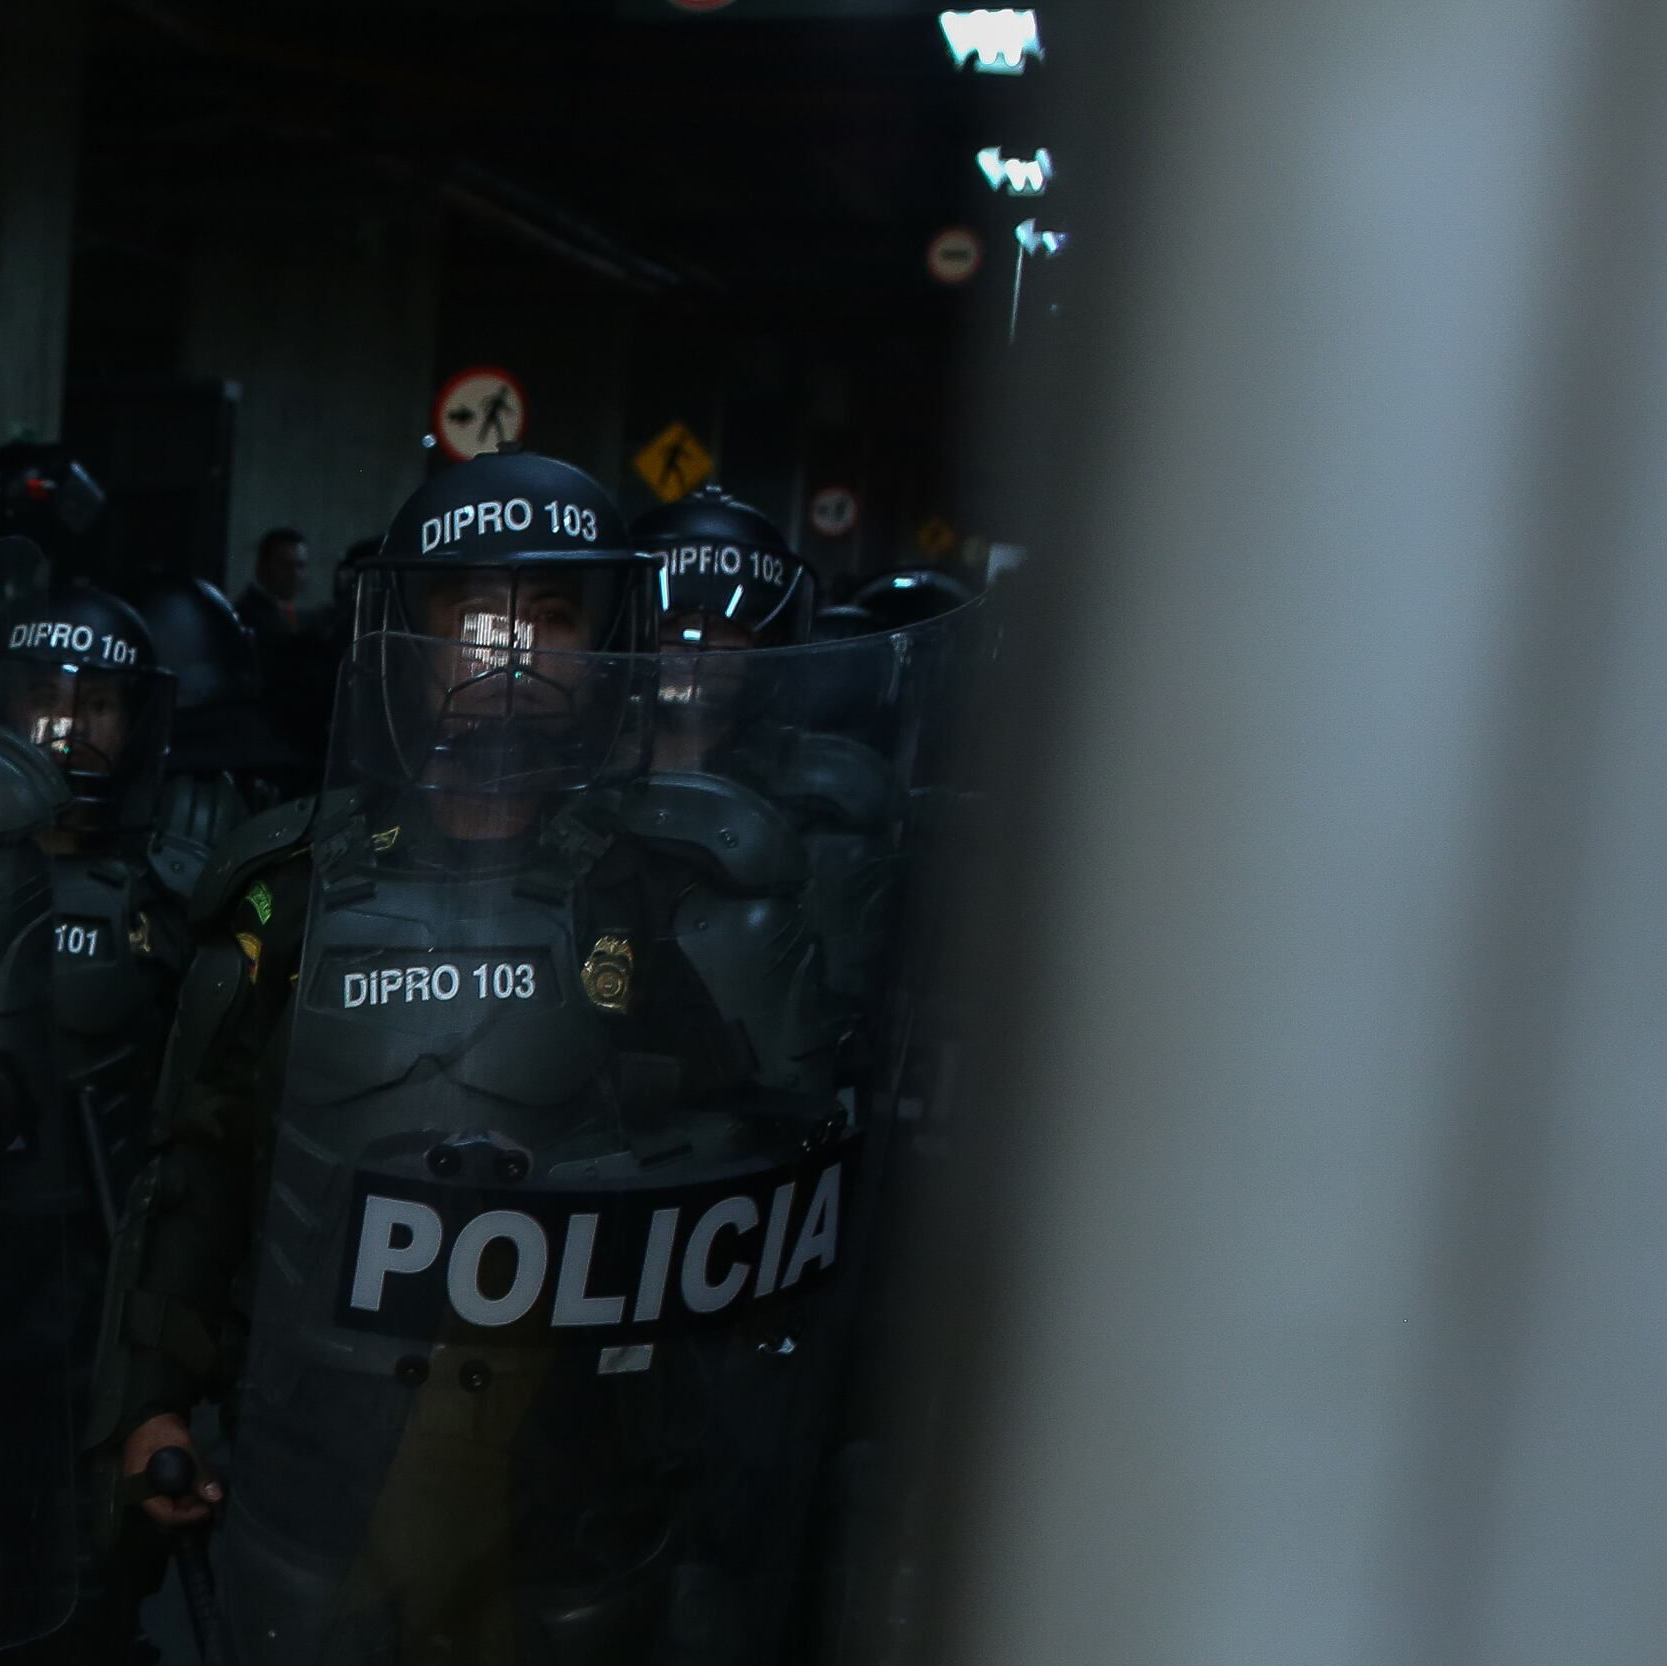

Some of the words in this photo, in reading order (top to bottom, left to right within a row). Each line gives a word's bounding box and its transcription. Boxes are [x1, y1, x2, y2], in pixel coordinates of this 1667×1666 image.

[420, 497, 534, 556] DIPRO
[543, 499, 599, 544] 103
[749, 551, 784, 587] 102
[9, 622, 94, 652] DIPRO
[101, 633, 137, 665] 101
[54, 923, 98, 957] 101
[343, 963, 460, 1009] DIPRO
[472, 963, 536, 999] 103
[350, 1162, 842, 1327] POLICIA
